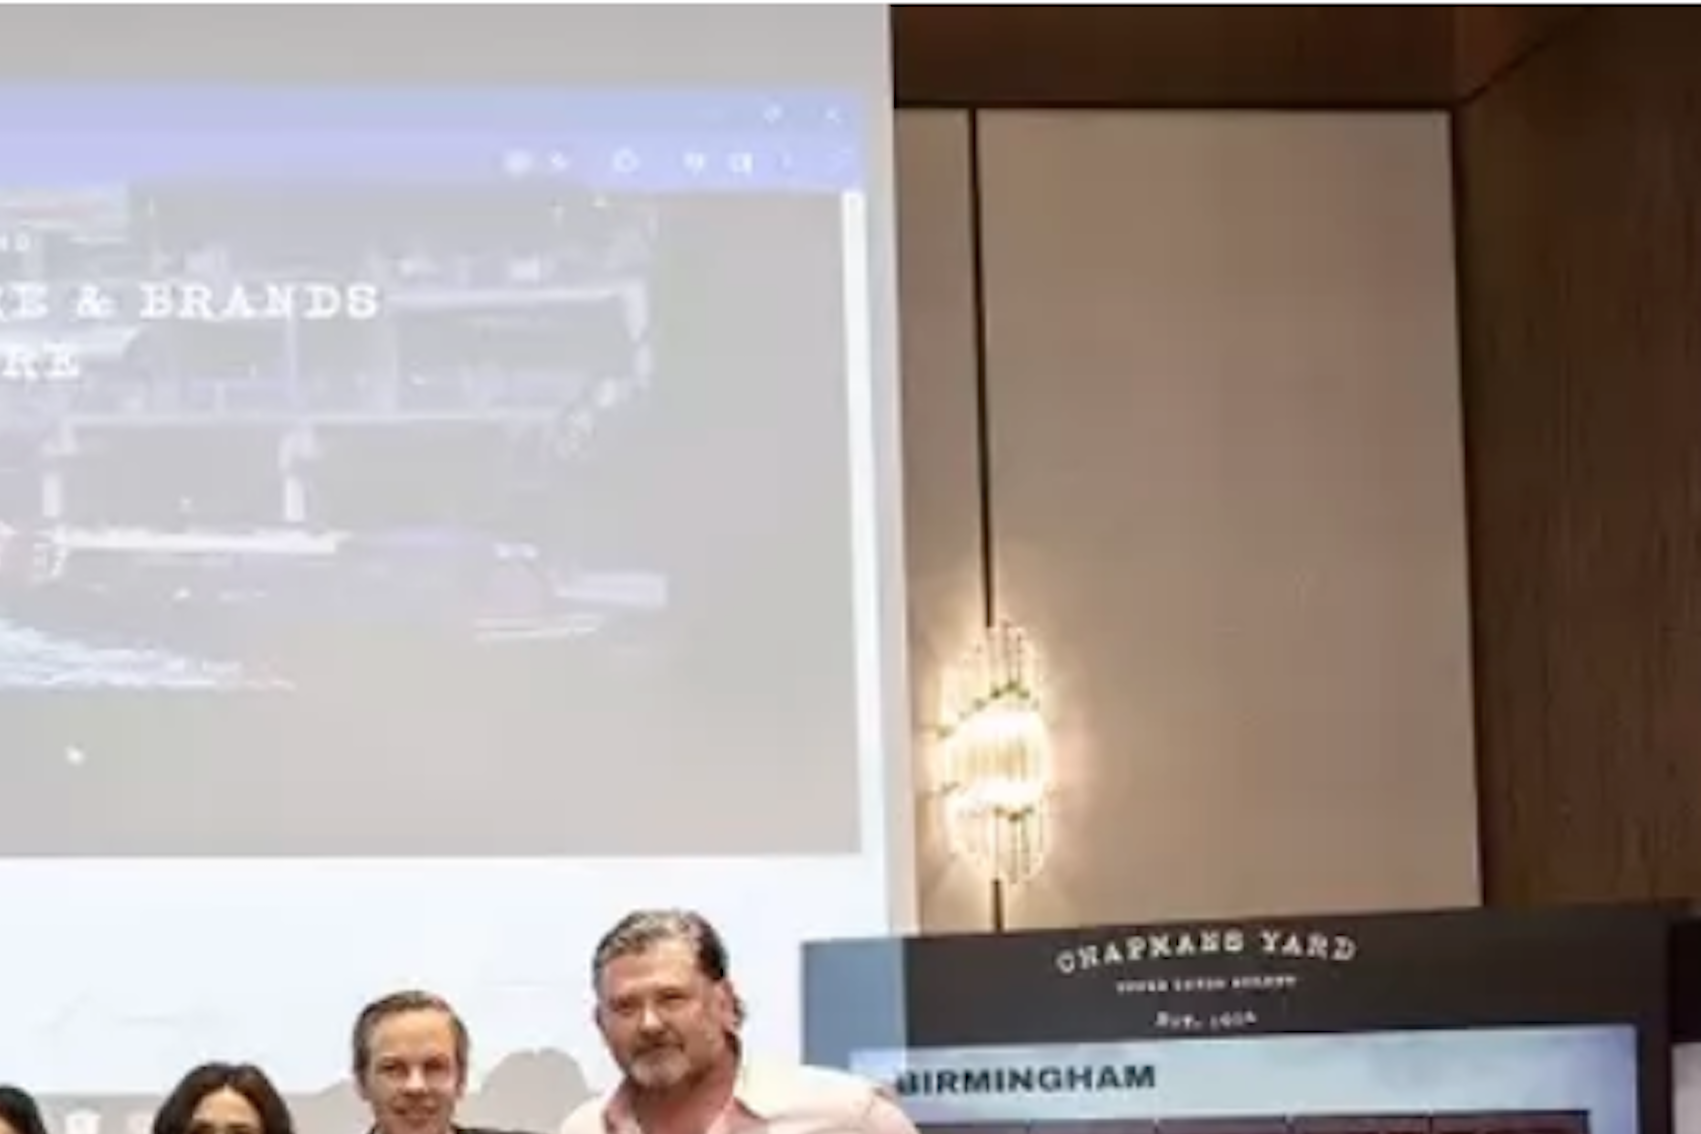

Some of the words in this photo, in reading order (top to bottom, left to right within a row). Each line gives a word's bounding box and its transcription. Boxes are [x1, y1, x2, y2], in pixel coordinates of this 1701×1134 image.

[75, 283, 115, 319] &
[140, 281, 381, 319] BRANDS
[1260, 930, 1357, 961] YARD
[897, 1064, 1157, 1096] BIRMINGHAM
